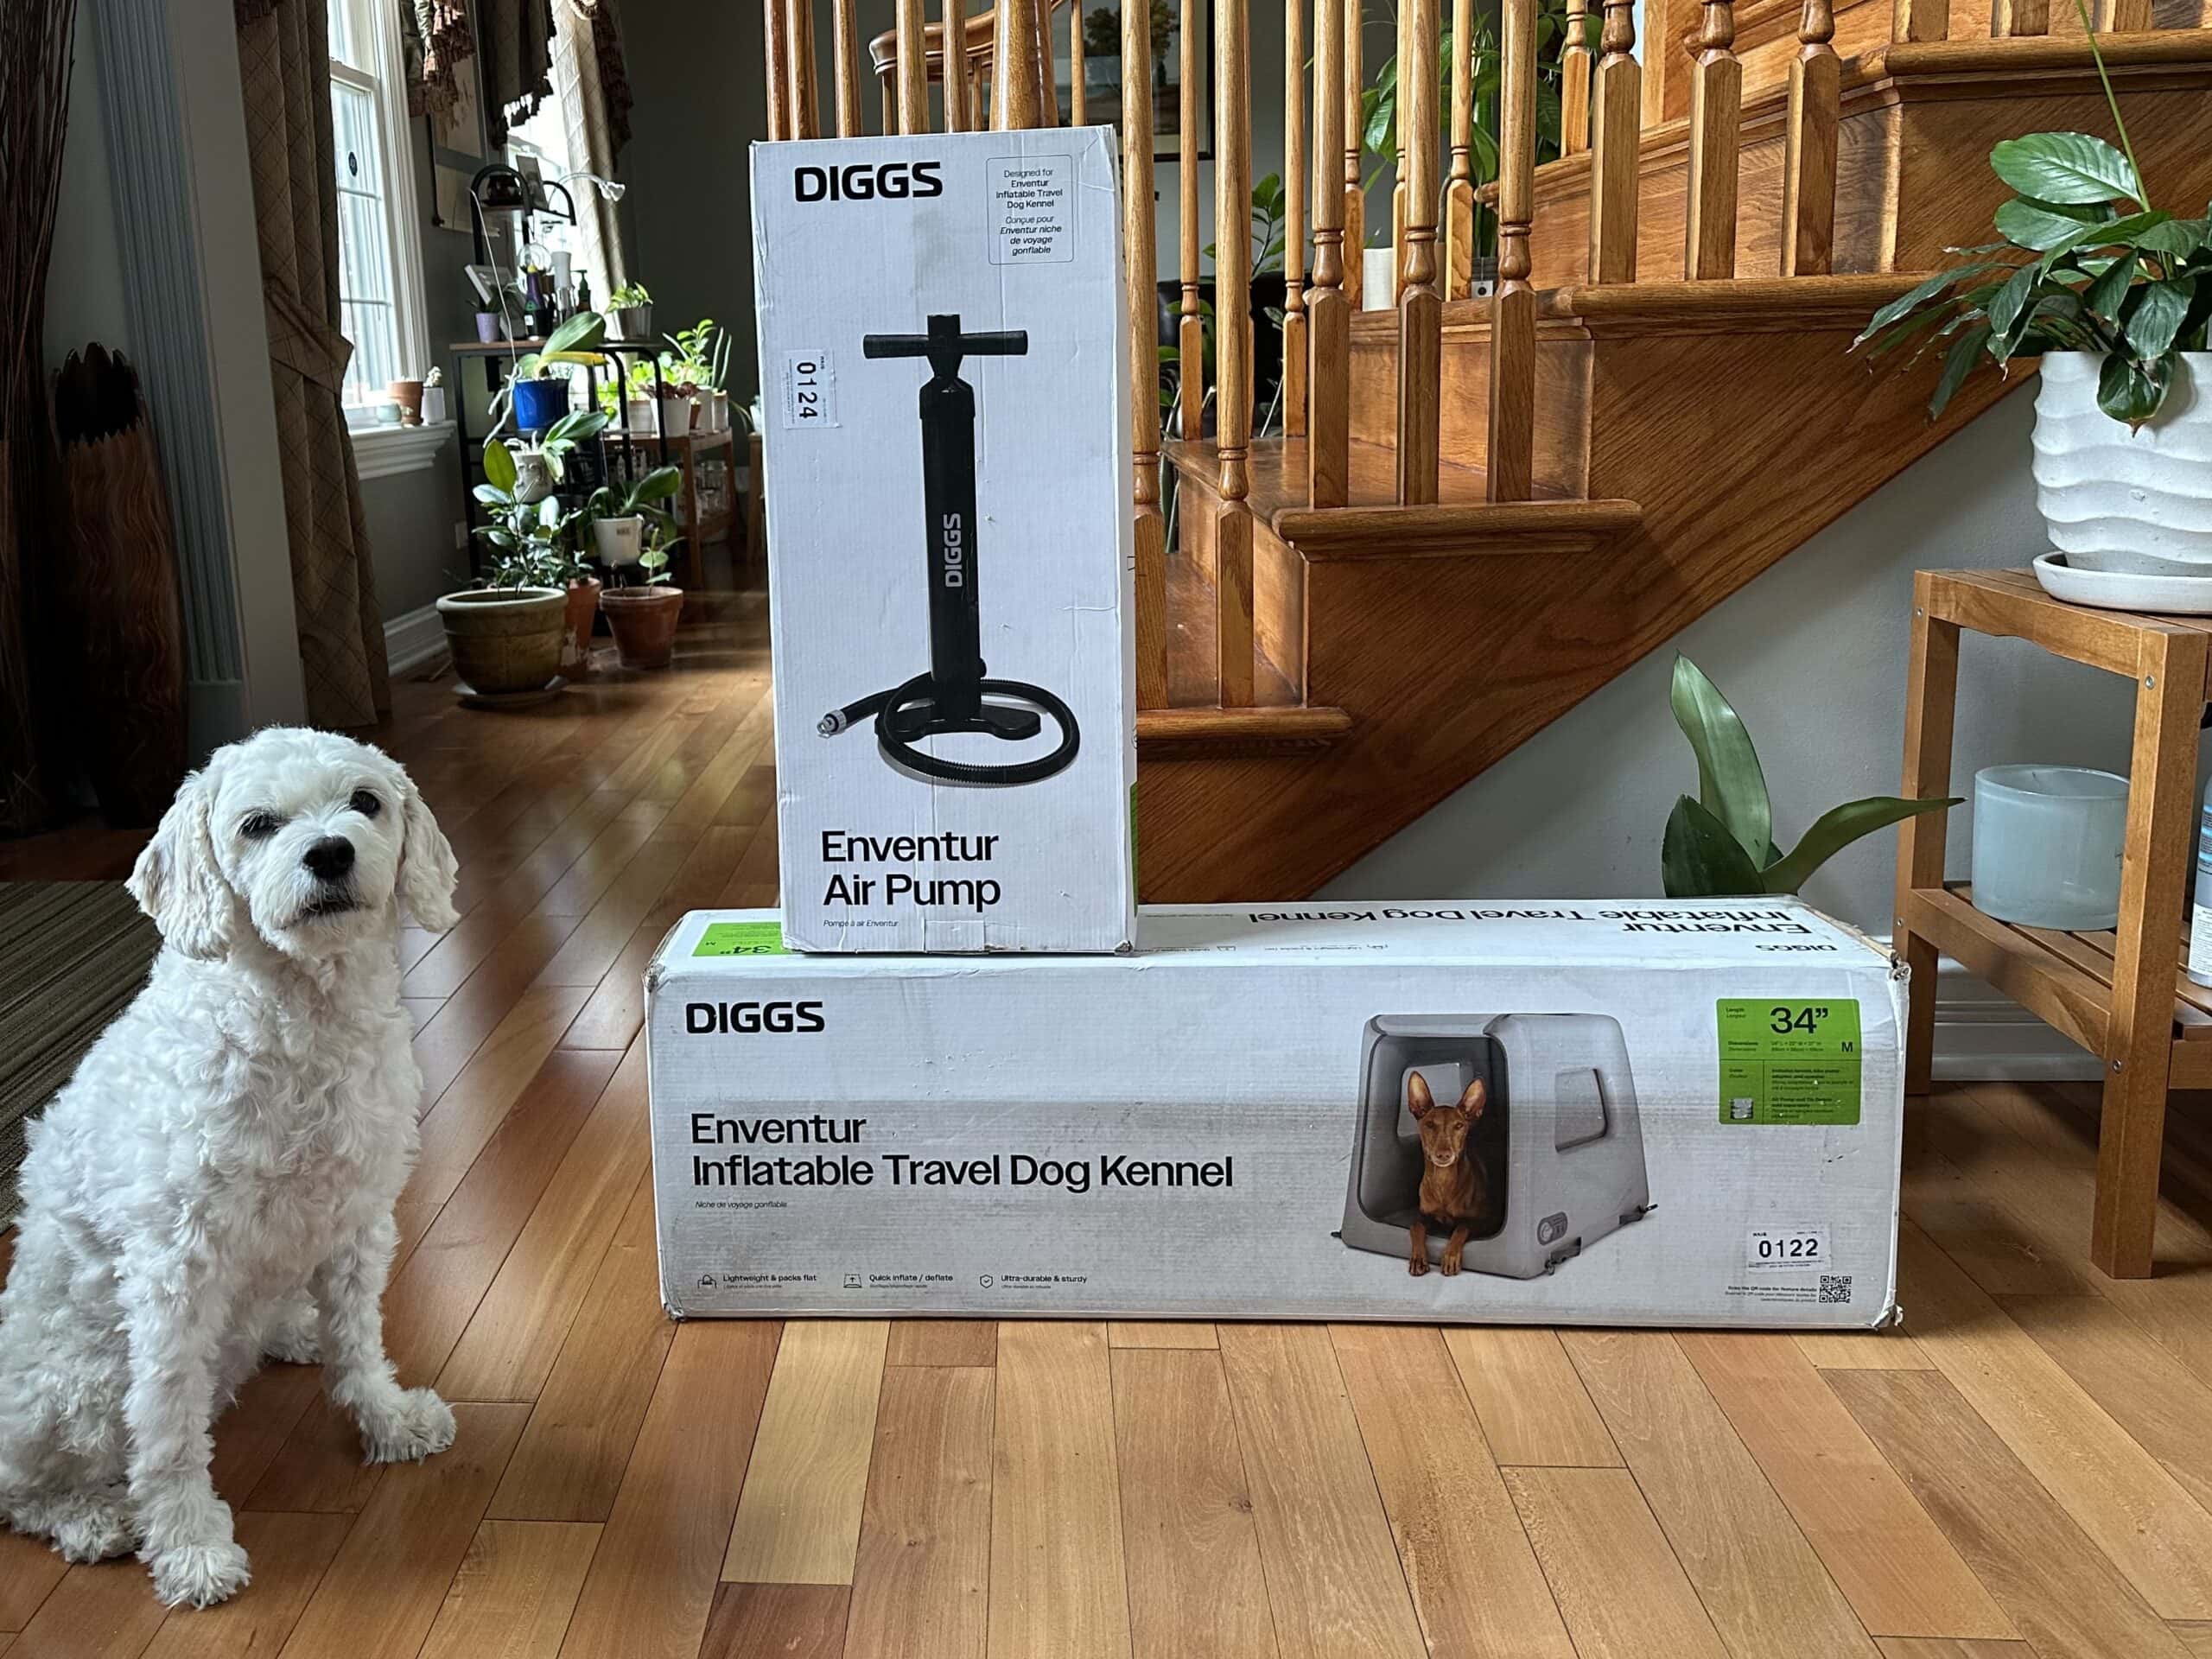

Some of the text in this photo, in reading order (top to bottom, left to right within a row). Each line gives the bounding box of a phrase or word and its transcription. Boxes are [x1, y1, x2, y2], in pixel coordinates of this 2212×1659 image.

[1003, 169, 1040, 178] Designed
[794, 162, 943, 201] DIGGS
[995, 188, 1063, 199] Inflatable Travel
[1007, 199, 1054, 210] Dog Kennel
[1023, 236, 1053, 245] voyage
[1012, 246, 1051, 256] gonflable
[797, 362, 818, 418] 0124
[943, 513, 963, 588] DIGGS
[821, 831, 999, 862] Enventur
[823, 874, 1001, 913] Air Pump
[1249, 908, 1792, 923] Inflatable Travel Dog Kennel
[1622, 923, 1813, 934] Enventur
[686, 1001, 825, 1034] DIGGS
[1841, 1041, 1853, 1052] M
[691, 1113, 867, 1144] Enventur
[692, 1154, 1232, 1193] Inflatable Travel Dog Kennel
[753, 1200, 787, 1209] gonflable
[1758, 1238, 1819, 1258] 0122
[723, 1274, 769, 1282] Lightweight
[869, 1274, 891, 1282] Quick
